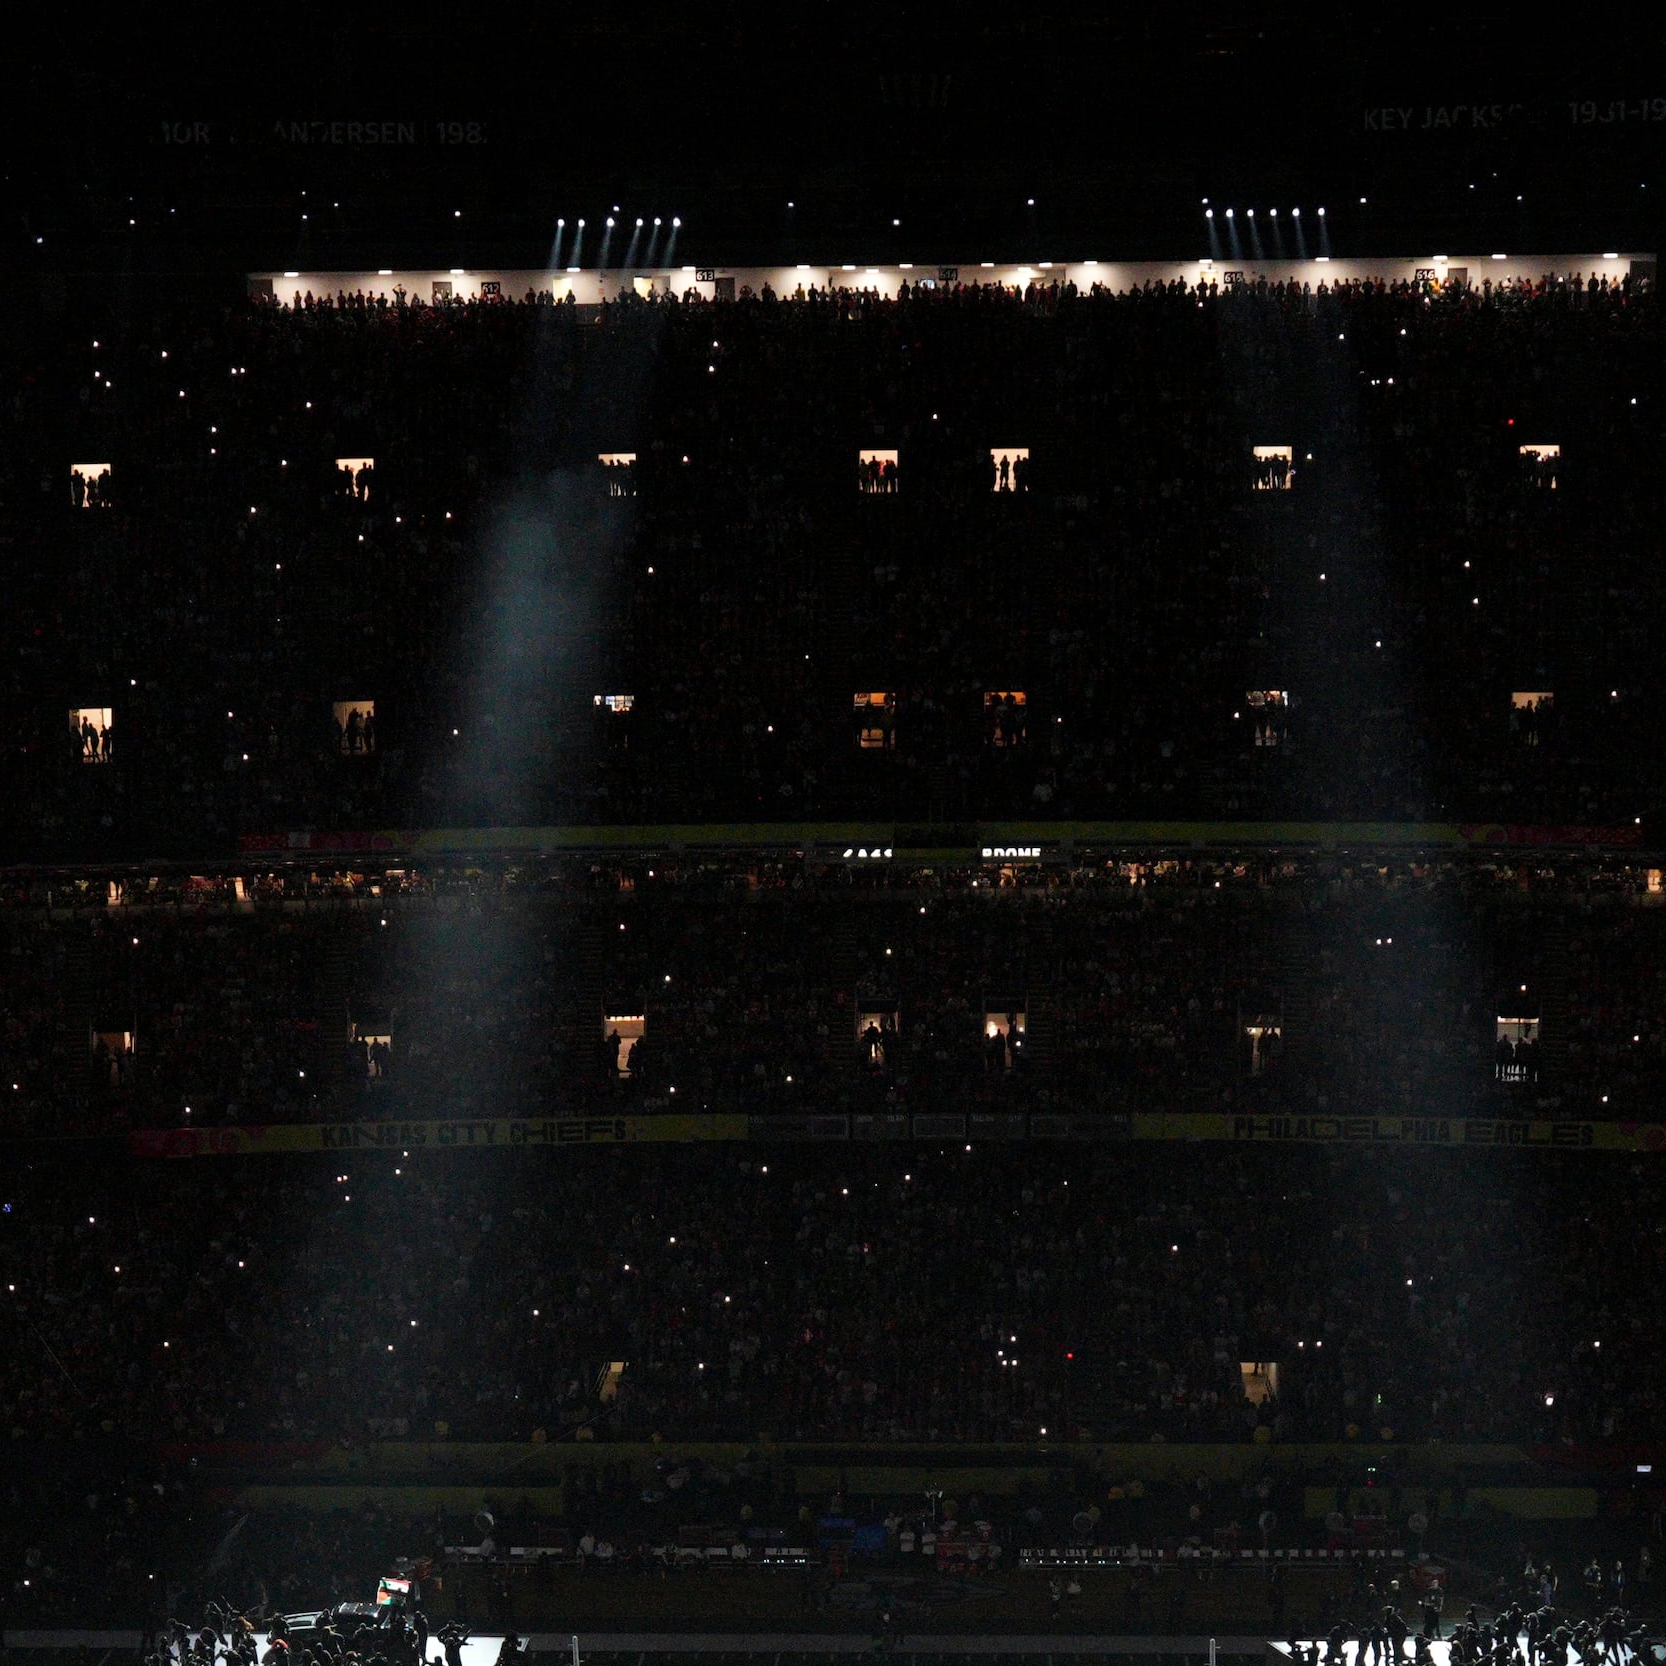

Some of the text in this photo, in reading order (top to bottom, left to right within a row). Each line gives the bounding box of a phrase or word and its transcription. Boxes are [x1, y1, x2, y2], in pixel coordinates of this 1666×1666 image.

[696, 271, 714, 281] 613
[1417, 270, 1434, 281] 616
[321, 1118, 627, 1149] KANSAS CITY CHIEFS
[1233, 1117, 1594, 1147] PHILADELPHIA EAGLES
